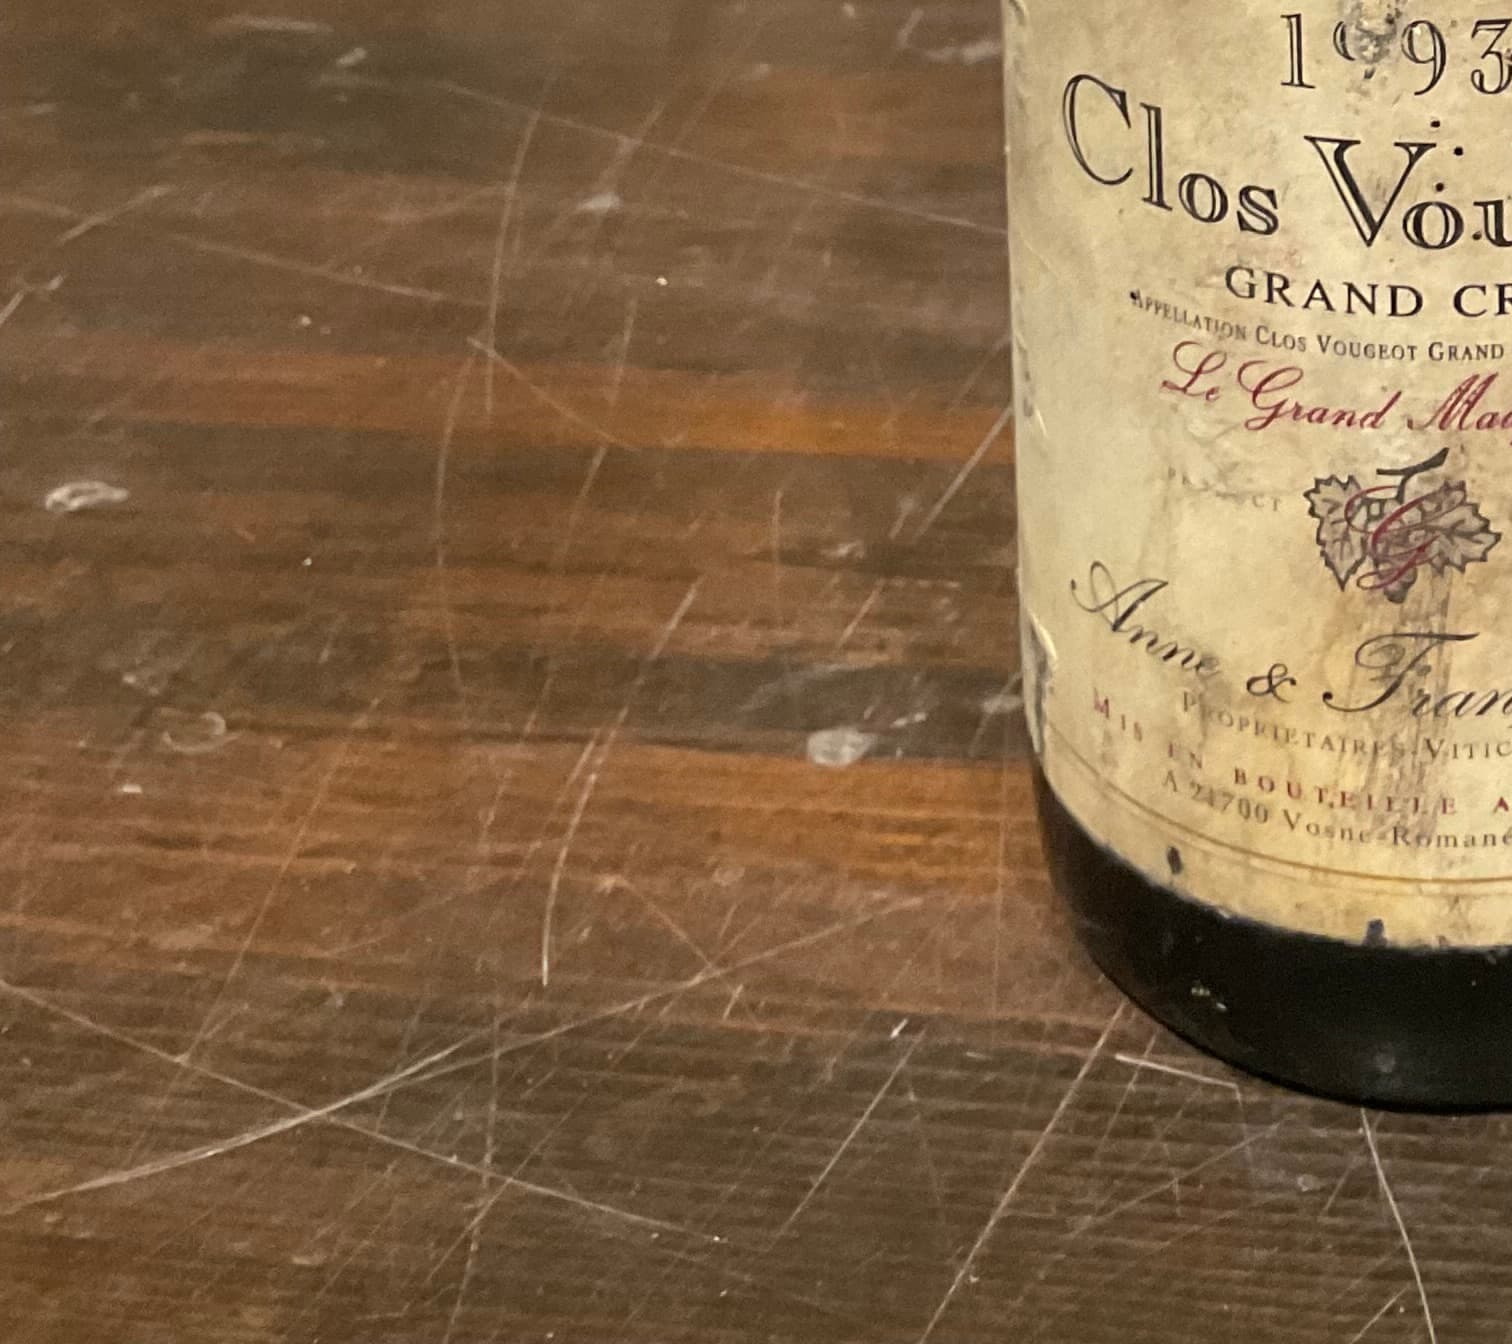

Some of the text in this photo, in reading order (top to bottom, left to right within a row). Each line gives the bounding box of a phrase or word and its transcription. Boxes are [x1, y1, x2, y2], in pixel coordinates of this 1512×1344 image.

[1062, 73, 1280, 236] Clos
[1224, 264, 1424, 318] GRAND
[1160, 339, 1229, 403] Le
[1236, 359, 1403, 432] Grand
[1071, 560, 1223, 681] Anne
[1245, 662, 1298, 705] &
[1161, 769, 1179, 793] A
